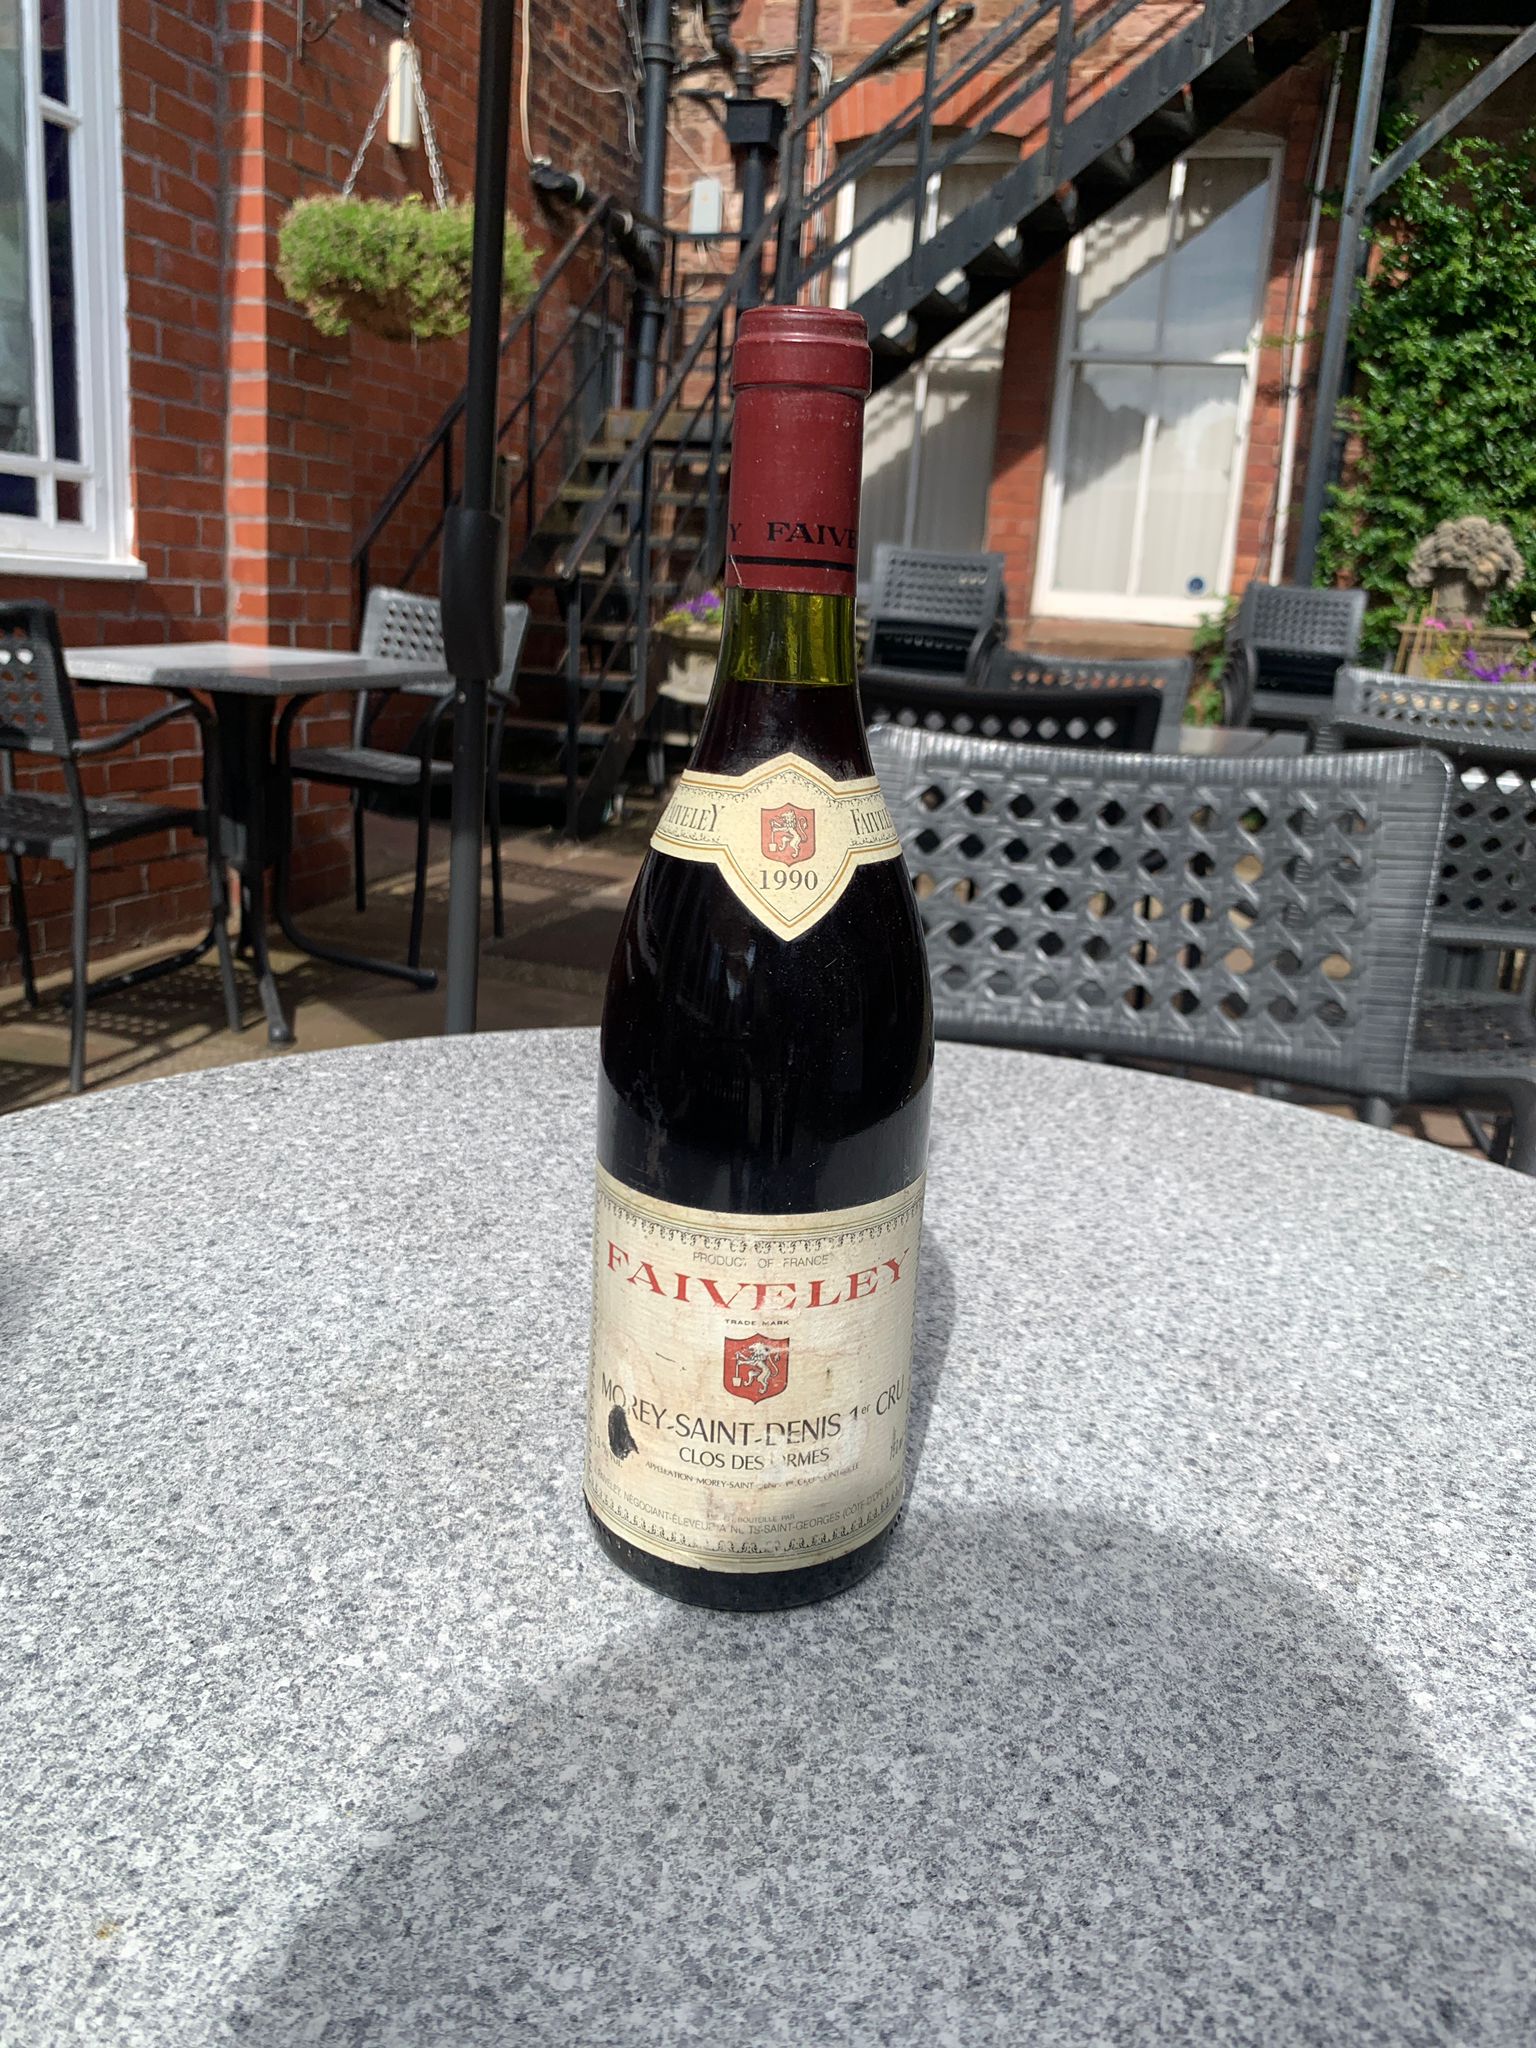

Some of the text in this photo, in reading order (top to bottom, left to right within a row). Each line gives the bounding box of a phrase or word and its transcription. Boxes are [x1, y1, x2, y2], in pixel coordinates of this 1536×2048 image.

[759, 869, 818, 891] 1990
[757, 1257, 776, 1269] OF
[783, 1254, 829, 1268] FRANCE
[606, 1239, 910, 1311] FAIVELEY
[724, 1318, 790, 1326] TRADE MARK
[876, 1373, 905, 1416] CRU
[679, 1446, 830, 1471] CLOS DES RMES
